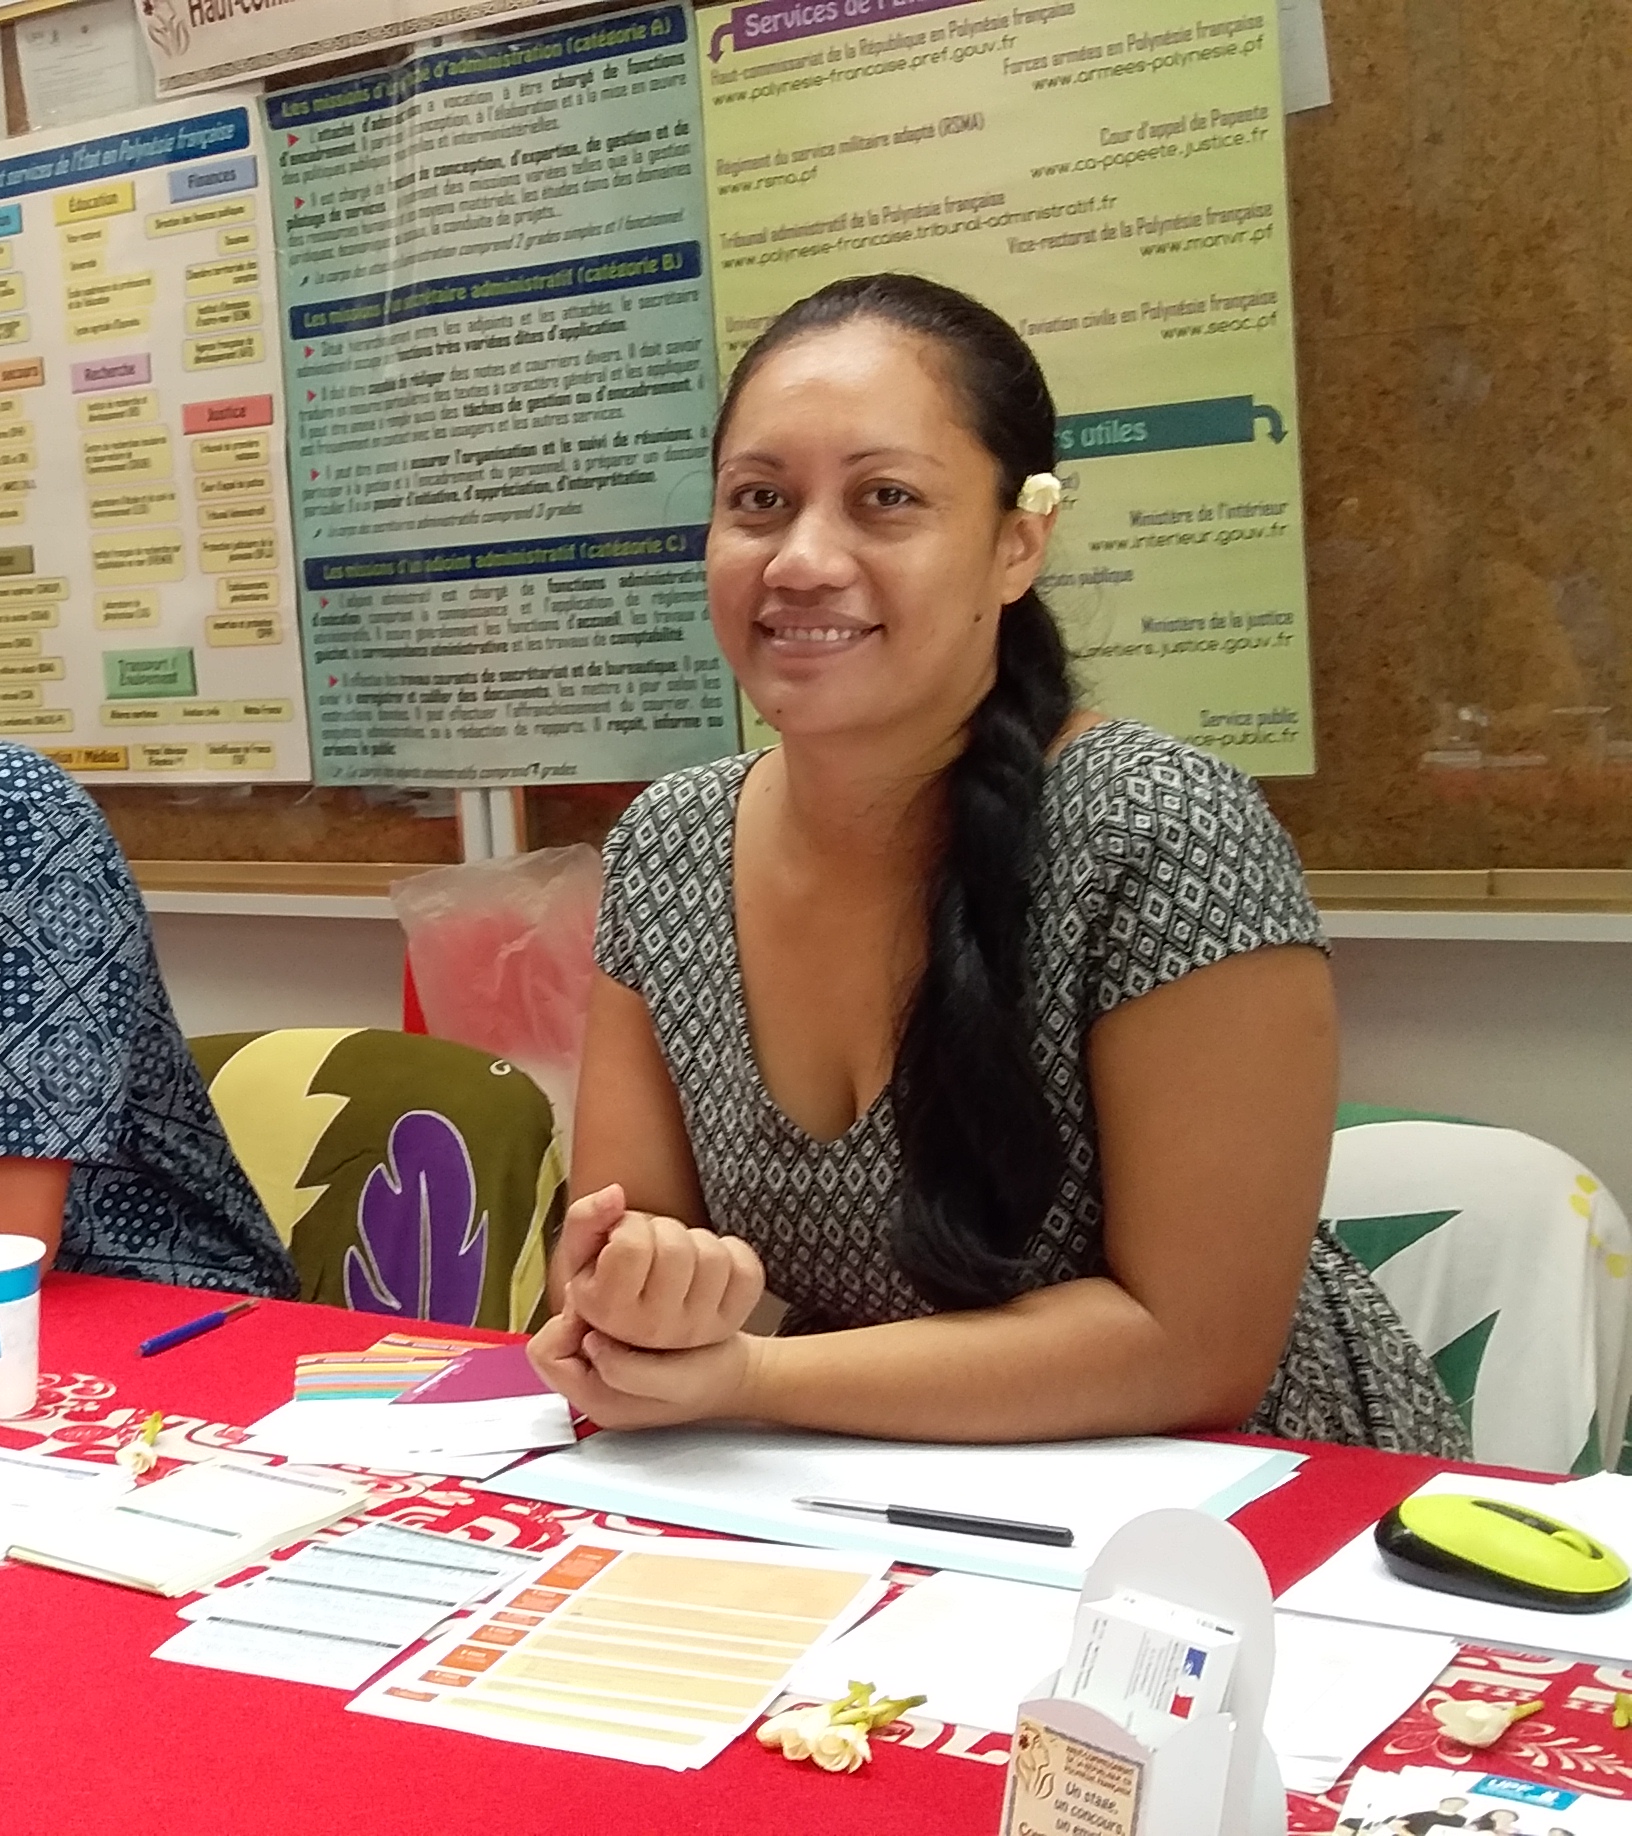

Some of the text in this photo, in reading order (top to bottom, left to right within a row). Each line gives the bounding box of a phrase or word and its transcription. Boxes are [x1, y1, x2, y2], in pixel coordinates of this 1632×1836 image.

[744, 1, 838, 37] Services
[1002, 13, 1264, 76] Forces armées en Polynésie française
[1032, 34, 1264, 91] www.armees-polynesie.pf
[938, 111, 985, 138] (RSMA)
[1100, 103, 1270, 147] Cour d'appel de Papeete
[1030, 126, 1269, 179] www.ca-papeete.justice.fr
[187, 167, 236, 189] Finances
[717, 166, 818, 196] www.rsma.pf
[1006, 201, 1274, 255] Vice-rectorat de la Polynésie française
[1082, 307, 1118, 329] civile
[1120, 309, 1138, 324] en
[1140, 296, 1206, 322] Polynésie
[1210, 287, 1278, 312] française
[1161, 311, 1278, 340] www.seac.pf
[1081, 419, 1149, 447] utiles
[1088, 522, 1289, 551] www.interieur.gouv.fr
[1200, 705, 1298, 729] Service public
[1065, 1781, 1082, 1799] Un
[1054, 1799, 1070, 1813] un
